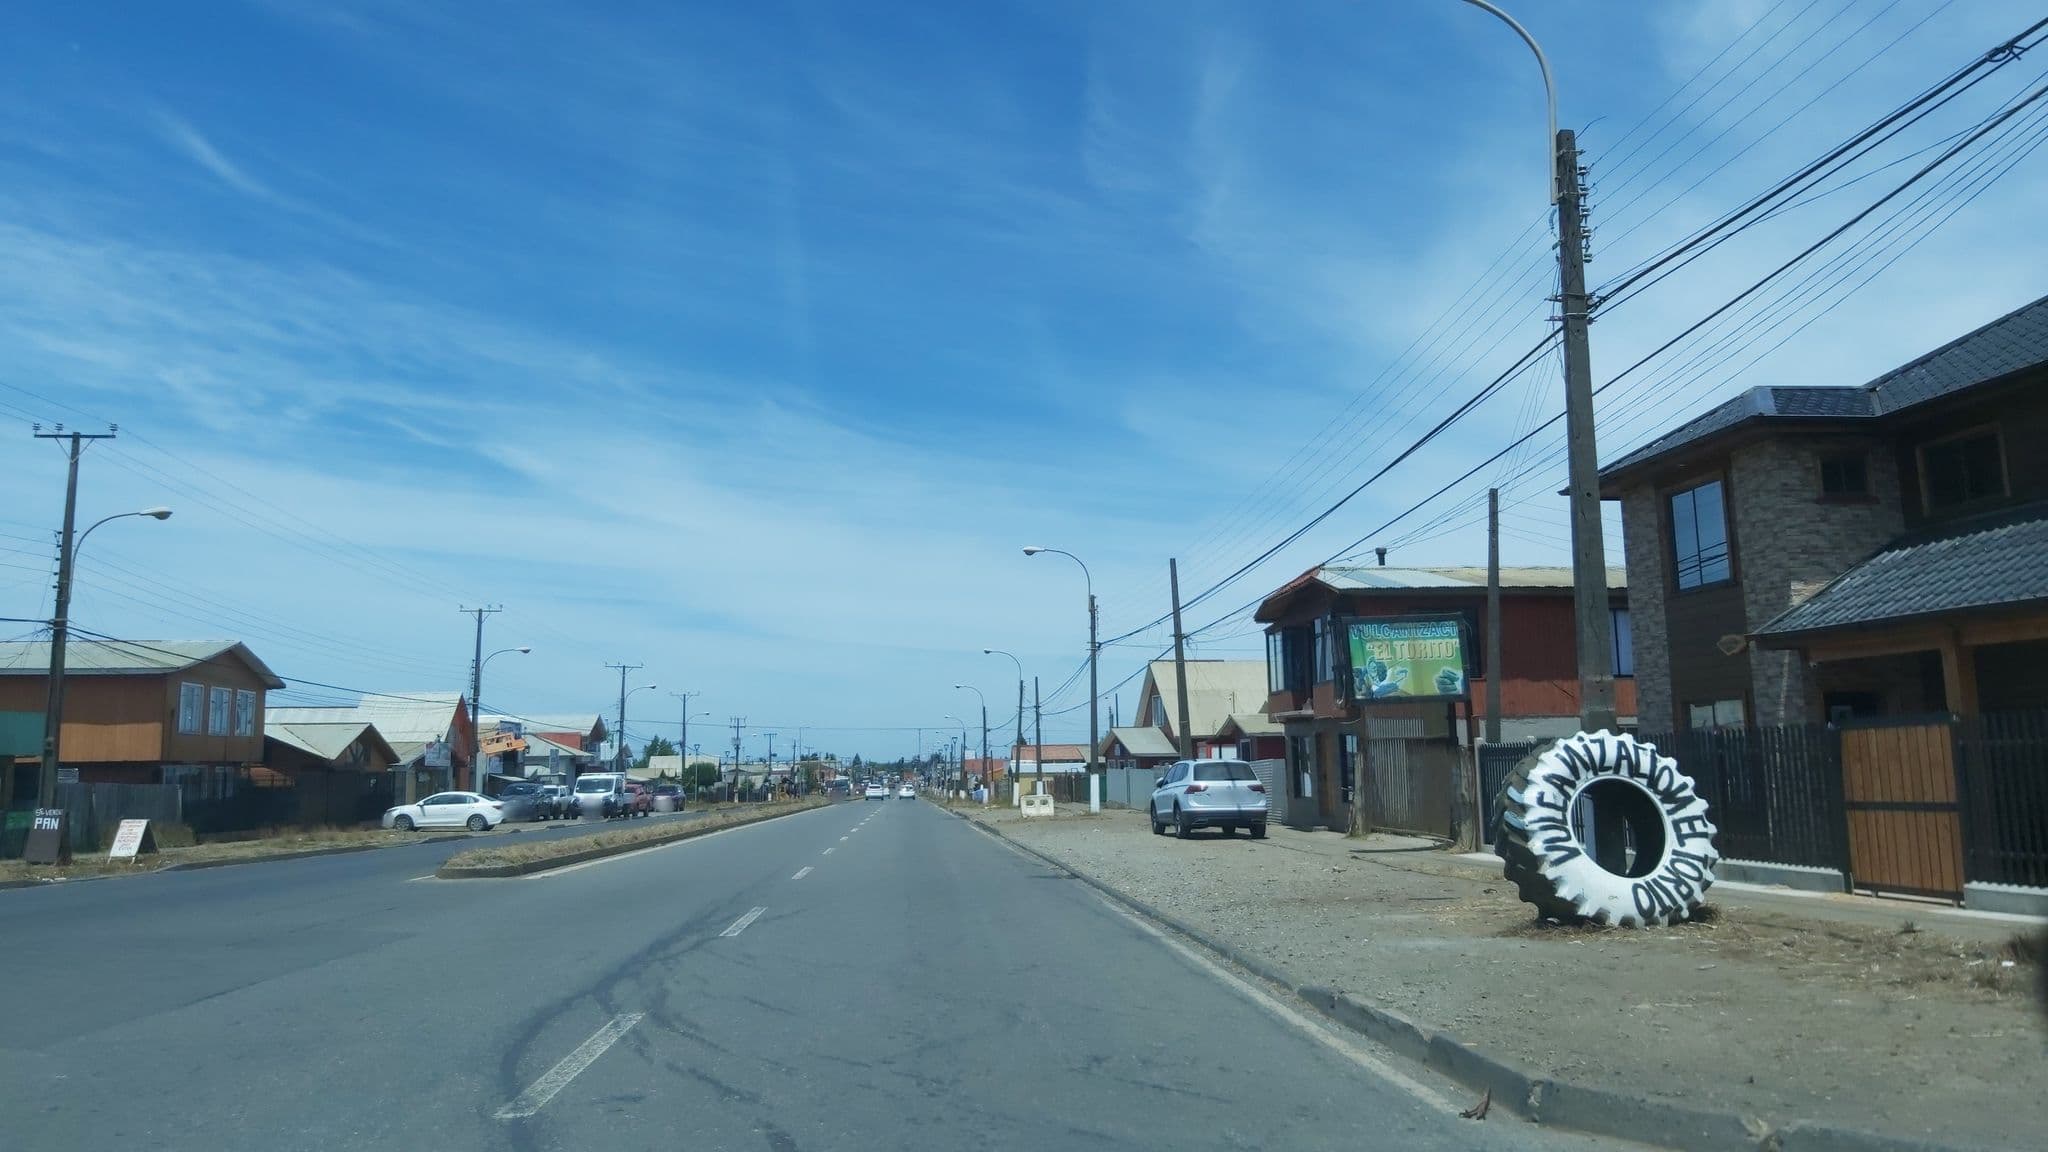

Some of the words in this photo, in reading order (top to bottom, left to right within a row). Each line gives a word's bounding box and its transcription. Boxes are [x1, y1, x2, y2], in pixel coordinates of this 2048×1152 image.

[34, 817, 60, 830] PAN
[1672, 815, 1708, 848] EL
[1632, 849, 1710, 919] TORITO
